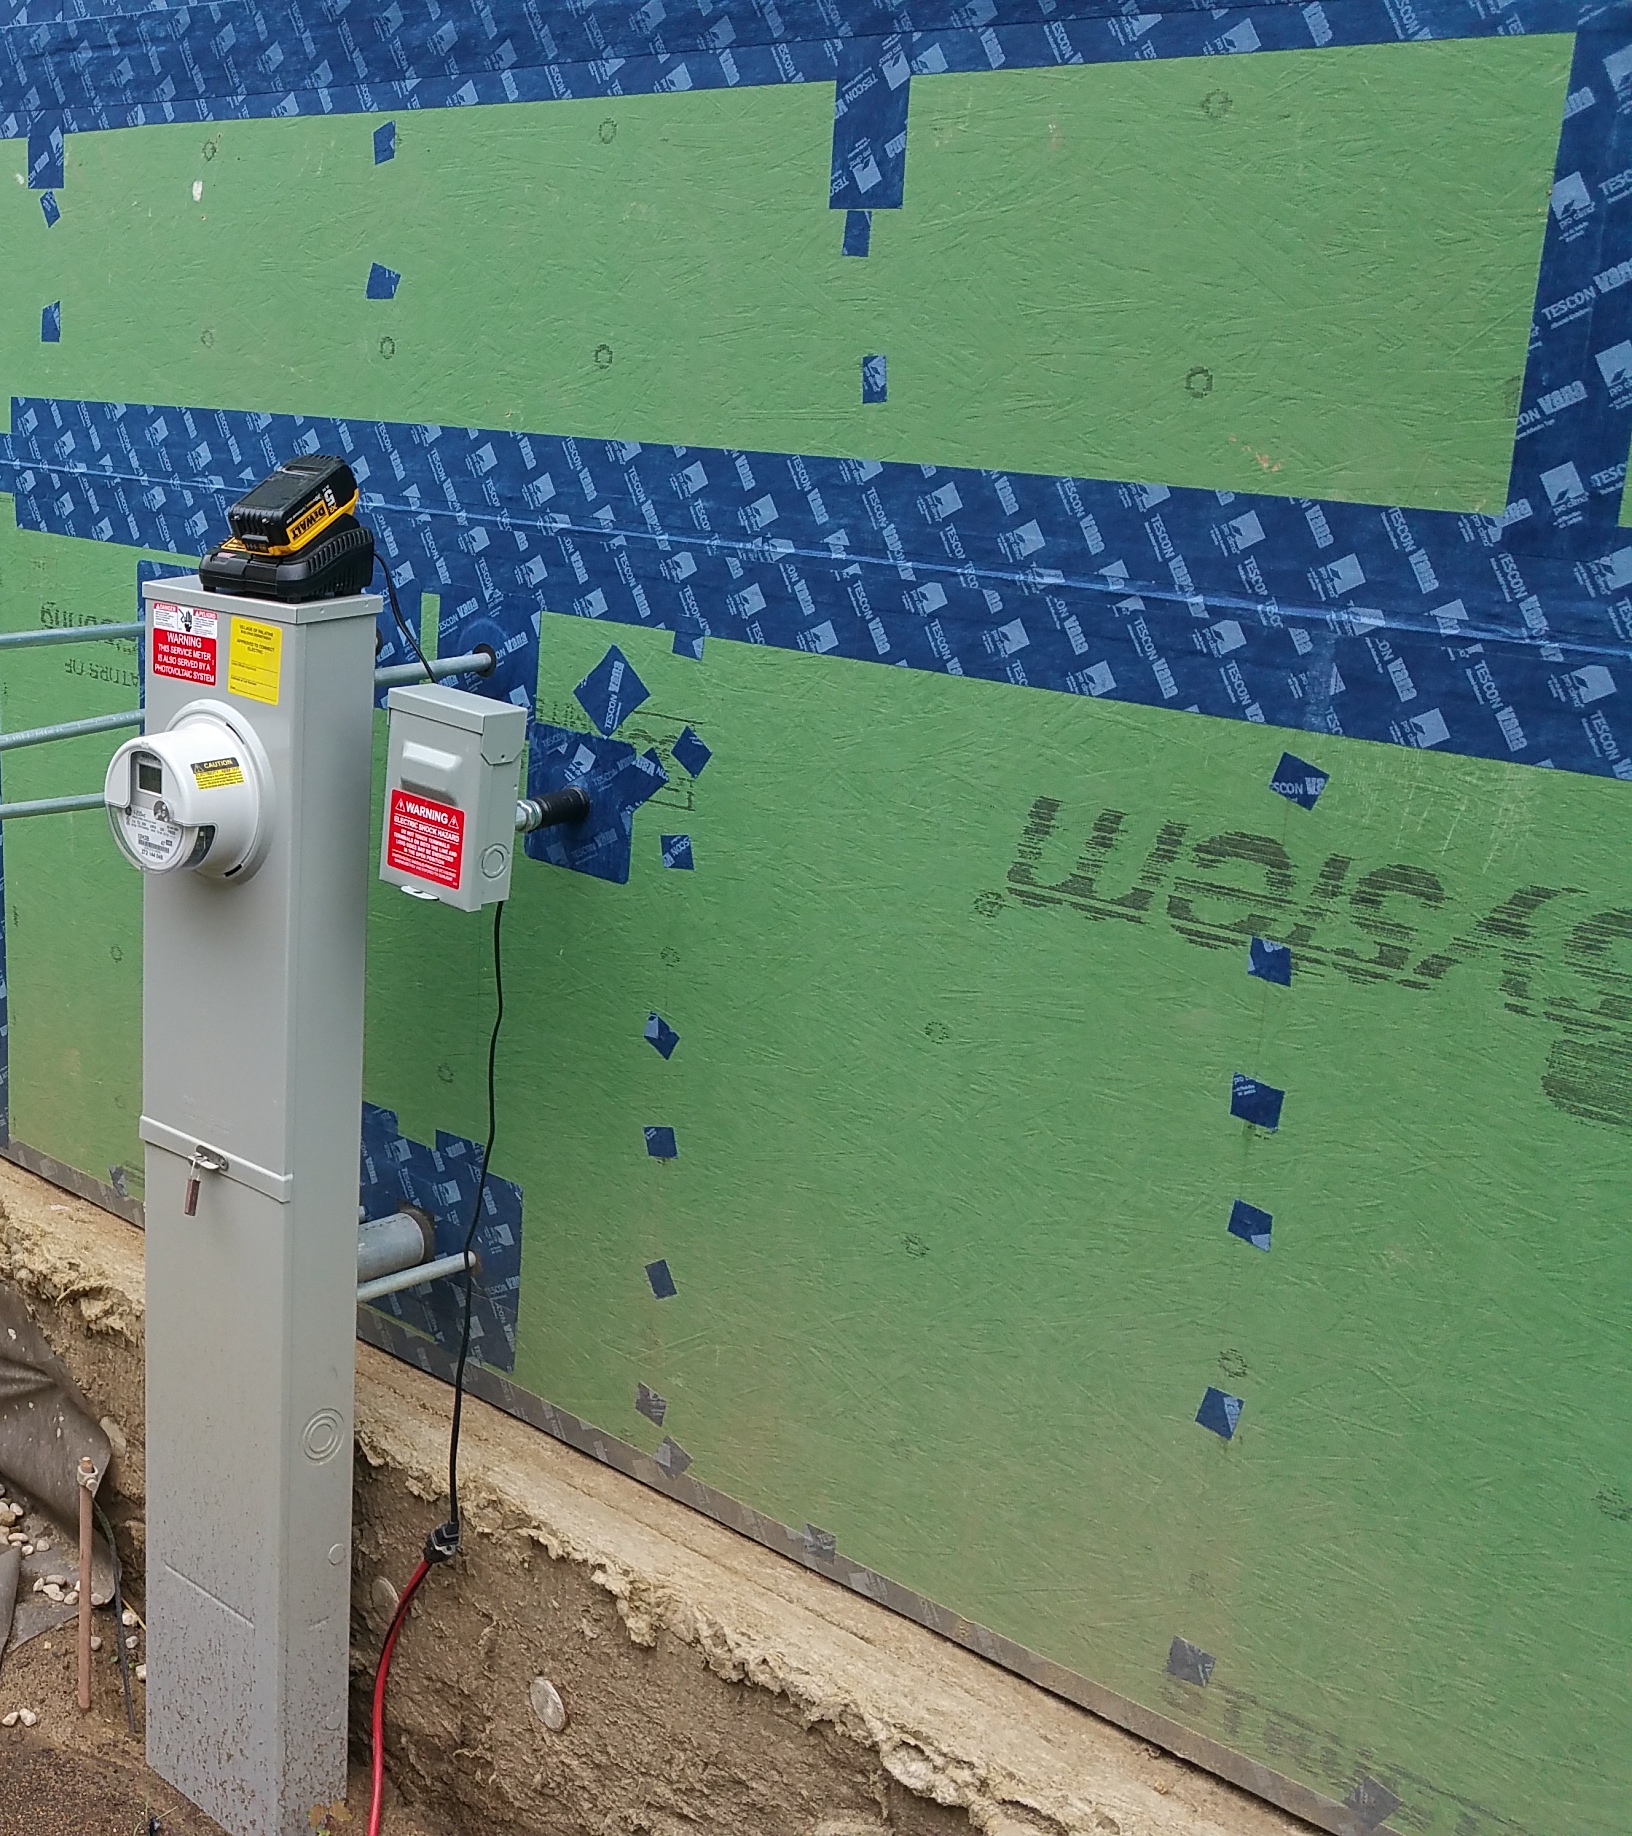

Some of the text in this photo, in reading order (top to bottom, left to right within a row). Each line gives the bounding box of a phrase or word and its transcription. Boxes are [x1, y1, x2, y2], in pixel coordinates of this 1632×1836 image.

[1541, 285, 1597, 321] TESCON
[167, 632, 202, 648] WARNING
[158, 644, 211, 661] THIS SERVICE METER
[158, 654, 211, 671] IS ALSO SERVED BY A
[155, 664, 214, 683] PHOTOVOLTAIC SYSTEM
[605, 694, 618, 729] TESCON
[204, 759, 233, 769] CAUTION
[406, 801, 448, 825] WARNING
[394, 816, 459, 842] ELECTRIC SHOCK HAZARD
